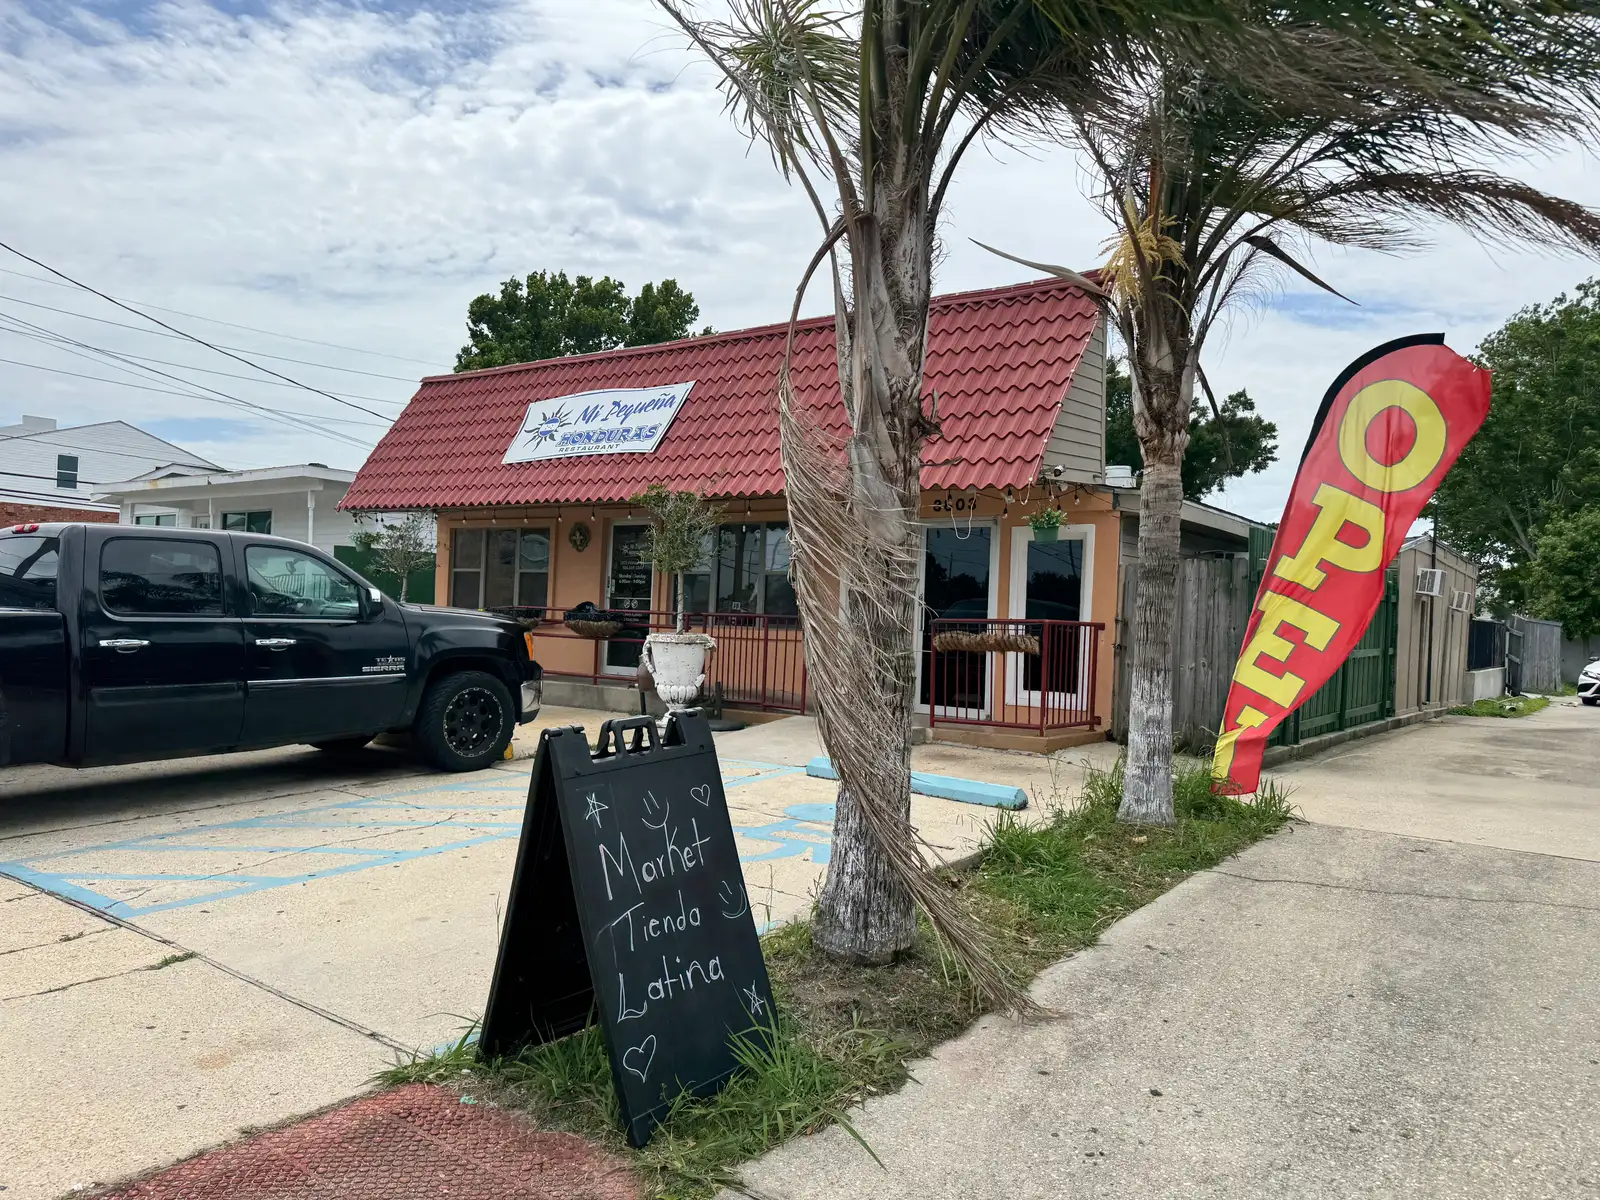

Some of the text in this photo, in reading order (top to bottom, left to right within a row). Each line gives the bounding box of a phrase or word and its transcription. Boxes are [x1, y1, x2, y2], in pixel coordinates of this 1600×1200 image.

[600, 392, 677, 425] Pequeña
[555, 423, 662, 447] HONDURAS
[558, 443, 621, 453] RESTAURANT
[599, 817, 711, 901] Market
[611, 889, 701, 952] Tienda
[616, 955, 725, 1024] Latina
